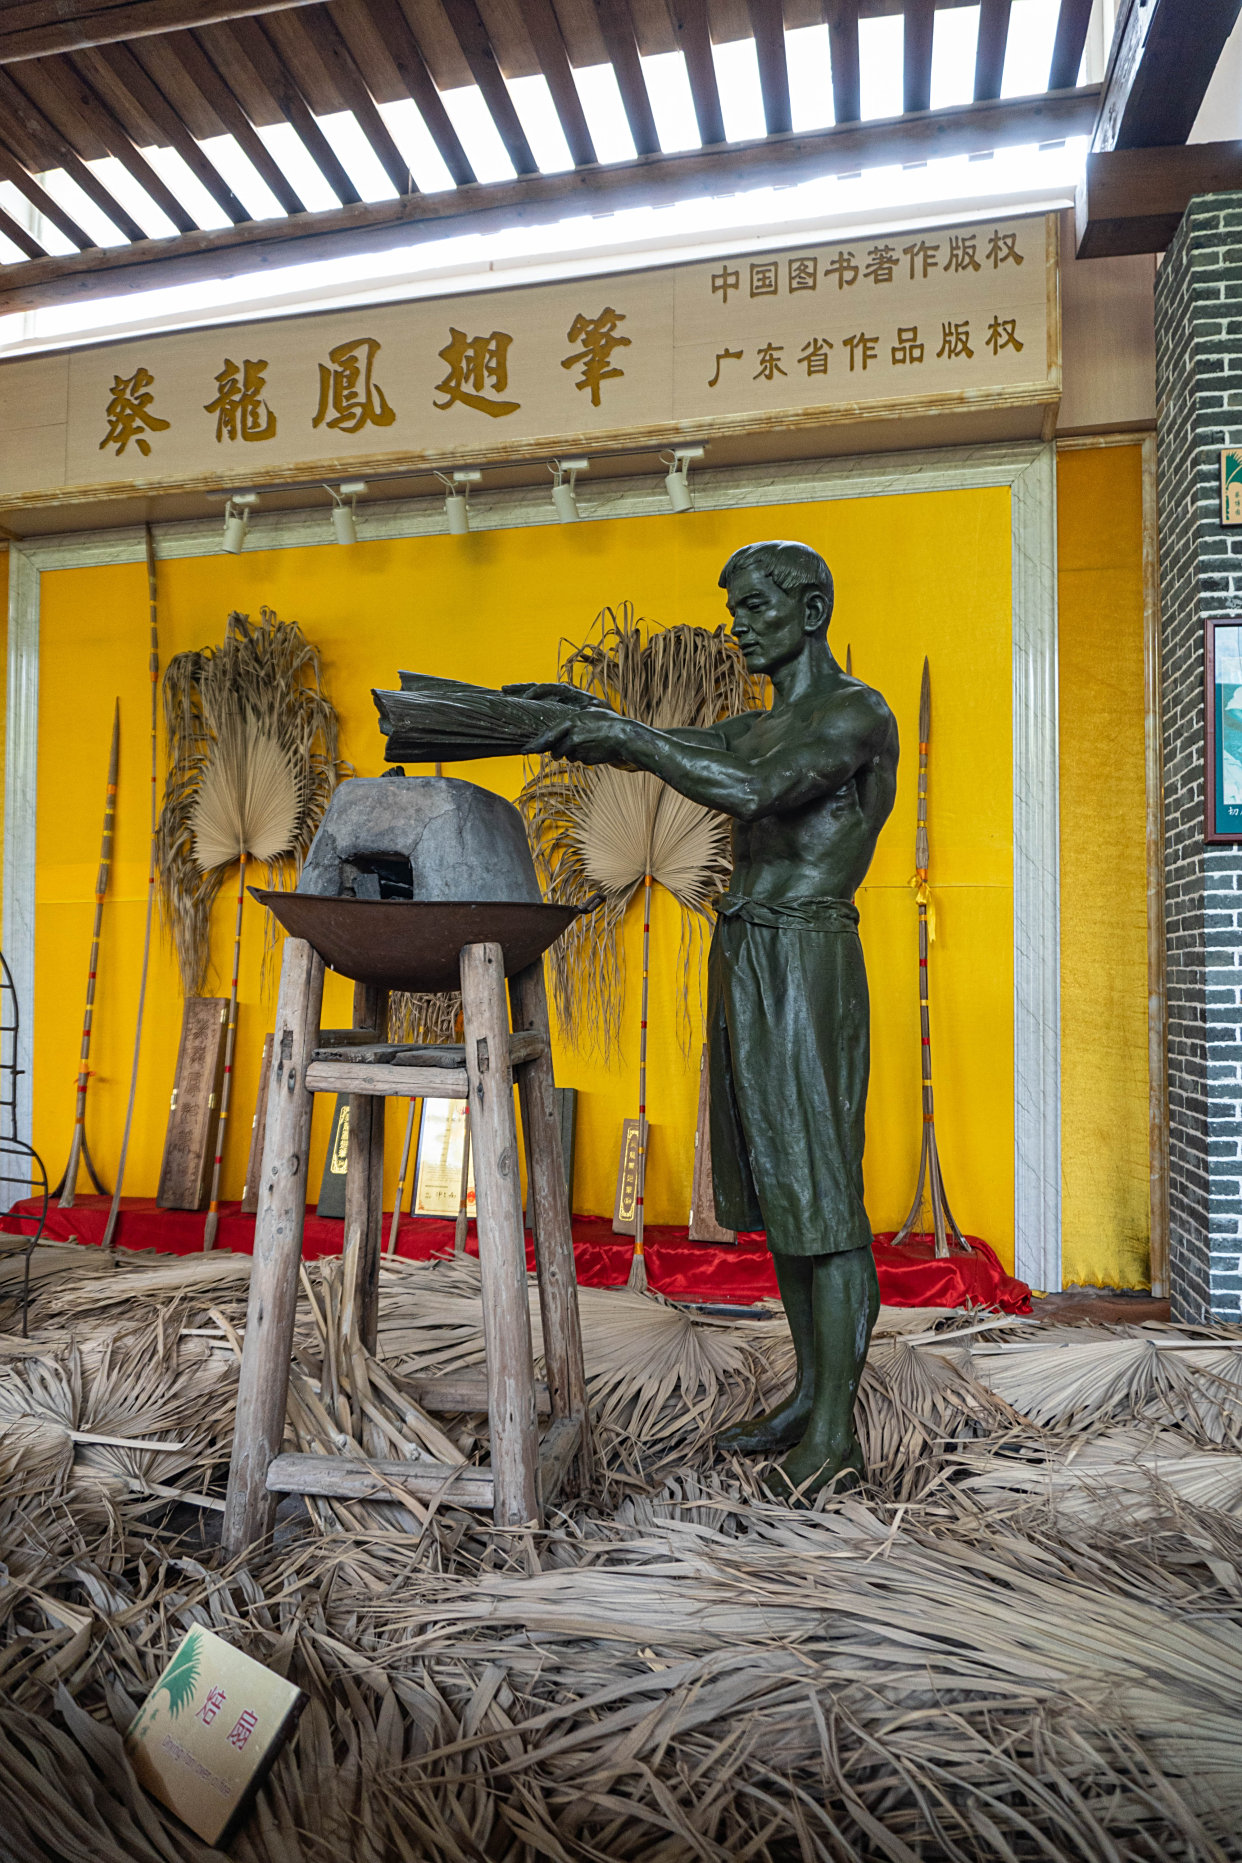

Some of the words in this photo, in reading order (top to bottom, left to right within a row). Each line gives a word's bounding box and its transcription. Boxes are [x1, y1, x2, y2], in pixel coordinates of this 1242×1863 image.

[711, 229, 1024, 304] 中国图书著作版权
[707, 315, 1025, 388] 广东省作品版权
